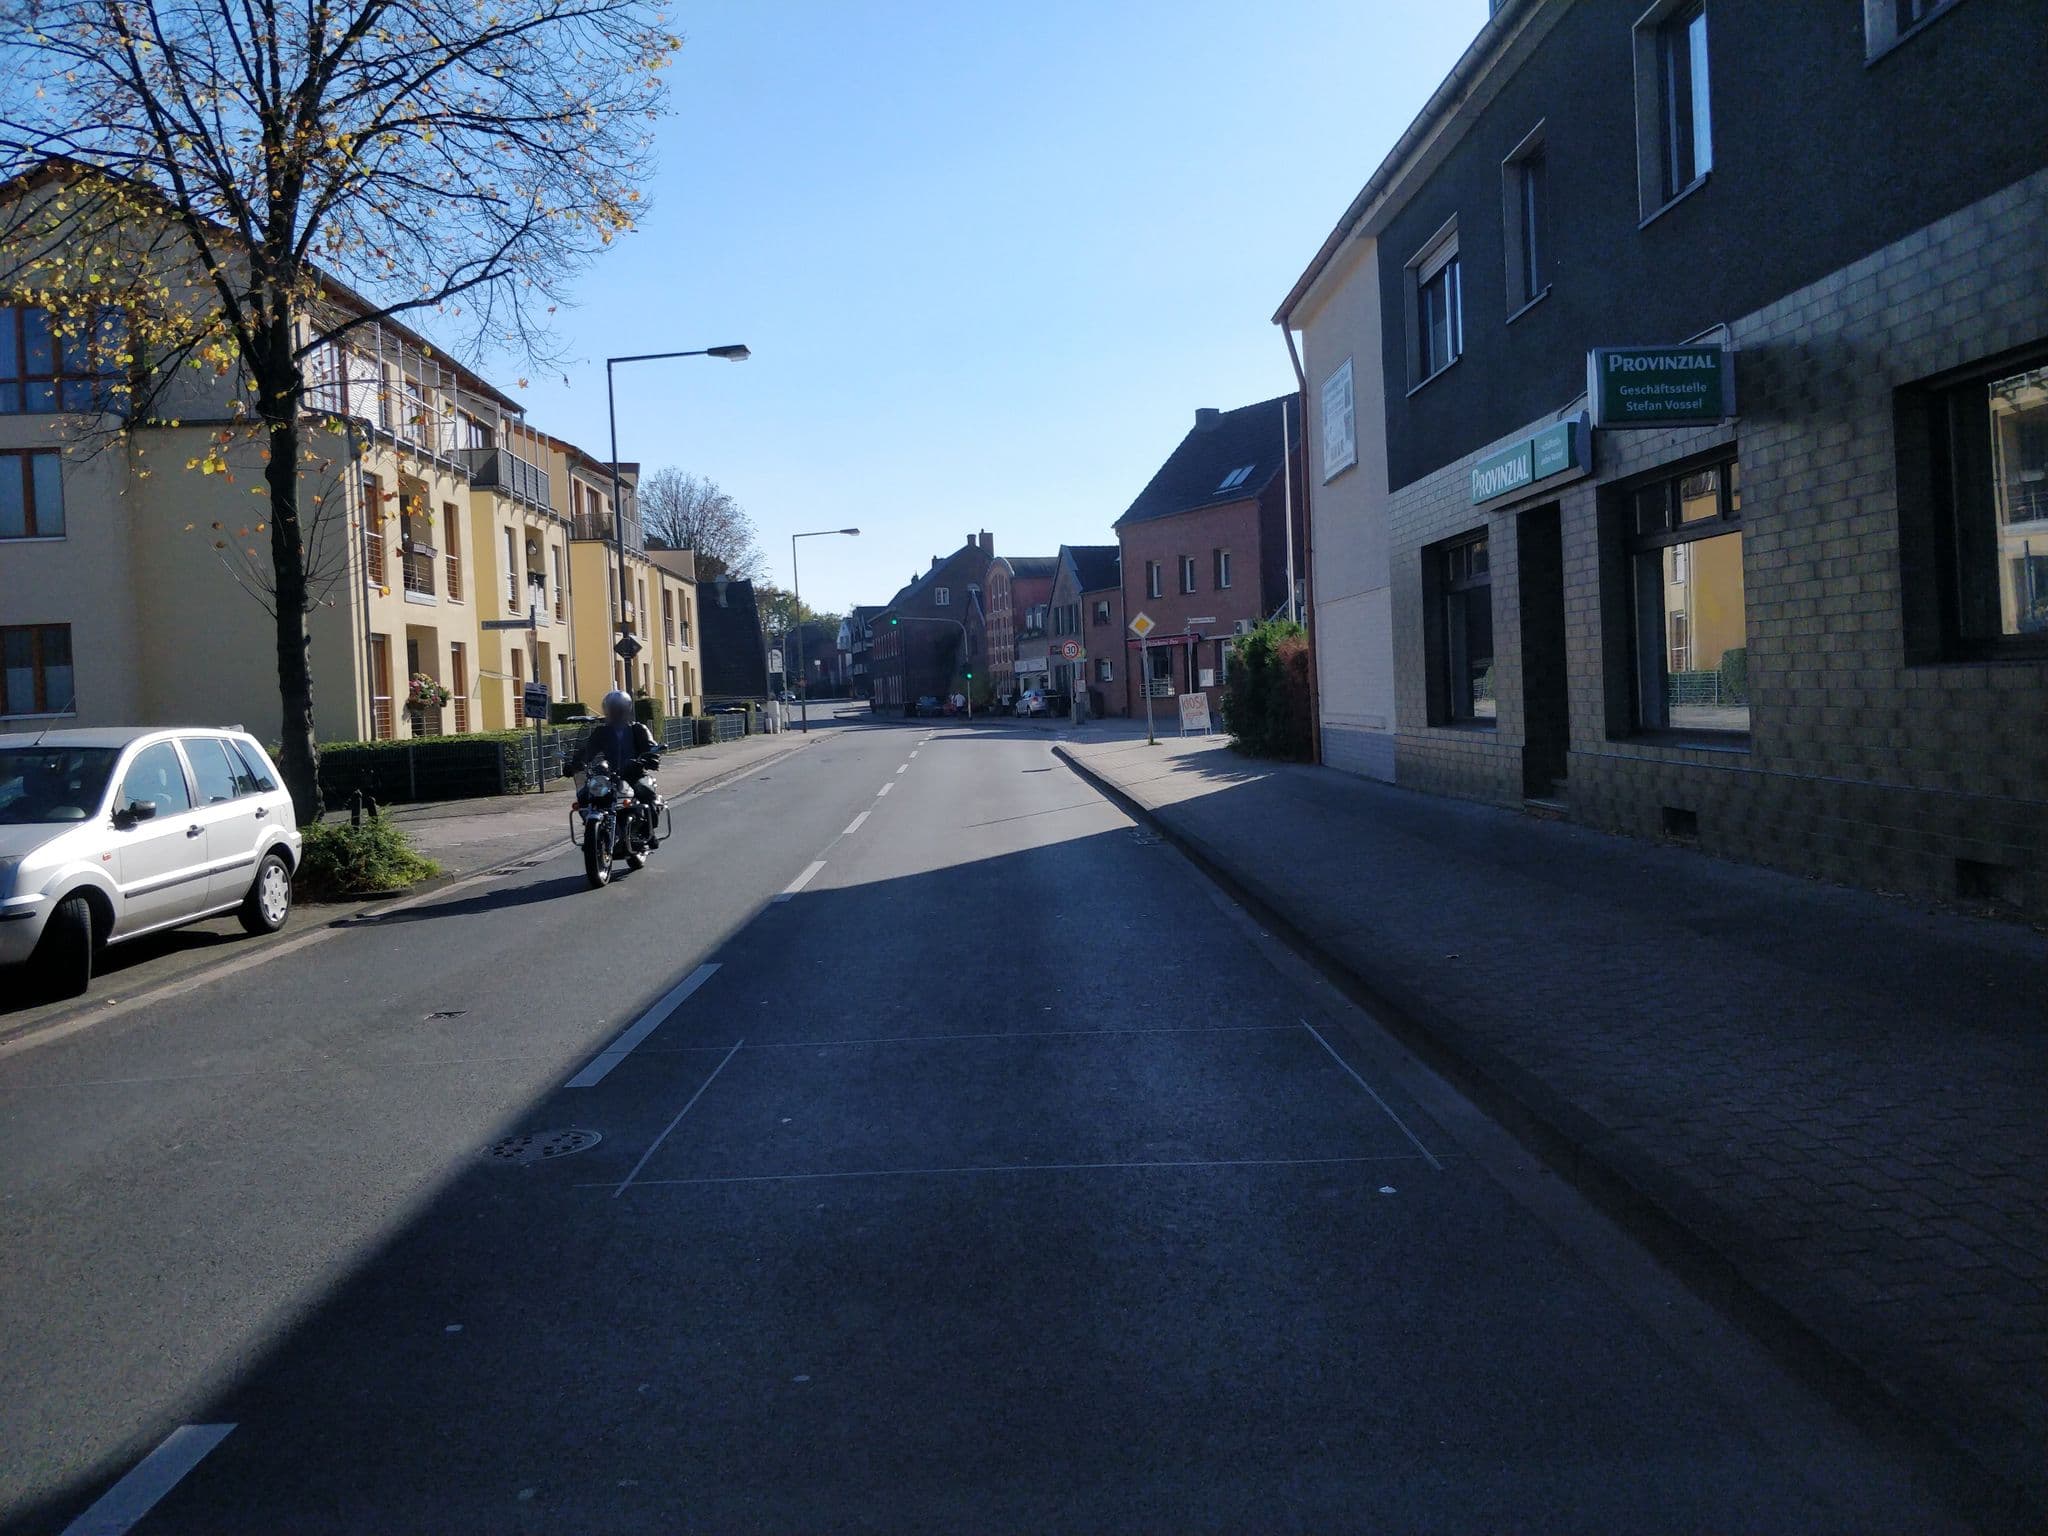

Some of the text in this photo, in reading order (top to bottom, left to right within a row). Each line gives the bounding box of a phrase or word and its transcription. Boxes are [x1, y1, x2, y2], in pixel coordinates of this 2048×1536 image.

[1609, 354, 1716, 372] PROVINZIAL
[1619, 382, 1708, 396] Geschäftsstelle
[1626, 398, 1703, 412] Stefan Vossel
[1472, 454, 1529, 499] PROVINZIAL
[1066, 645, 1076, 655] 30
